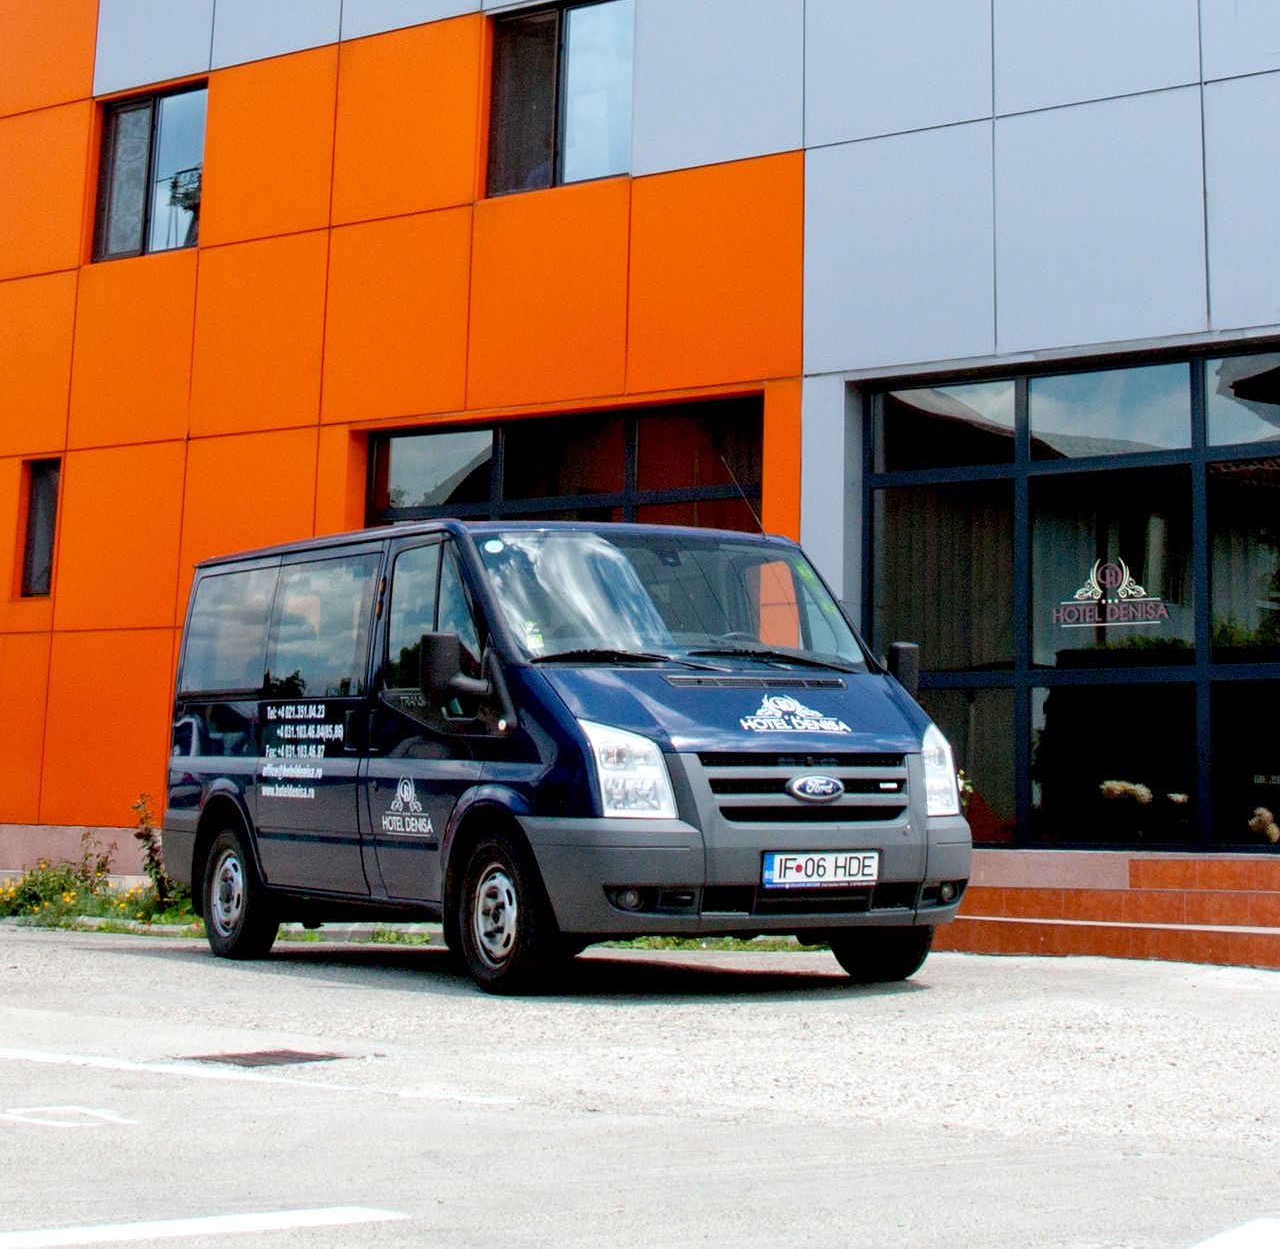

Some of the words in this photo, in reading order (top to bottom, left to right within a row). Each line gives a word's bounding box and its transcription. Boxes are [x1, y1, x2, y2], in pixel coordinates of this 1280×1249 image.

[1052, 605, 1102, 624] HOTEL
[1106, 602, 1169, 621] DENISA
[740, 718, 792, 731] HOTEL
[794, 719, 852, 732] DENISA
[806, 779, 833, 794] Ford
[382, 815, 404, 832] HOTEL
[406, 816, 434, 833] DENISA
[834, 856, 875, 877] HDE
